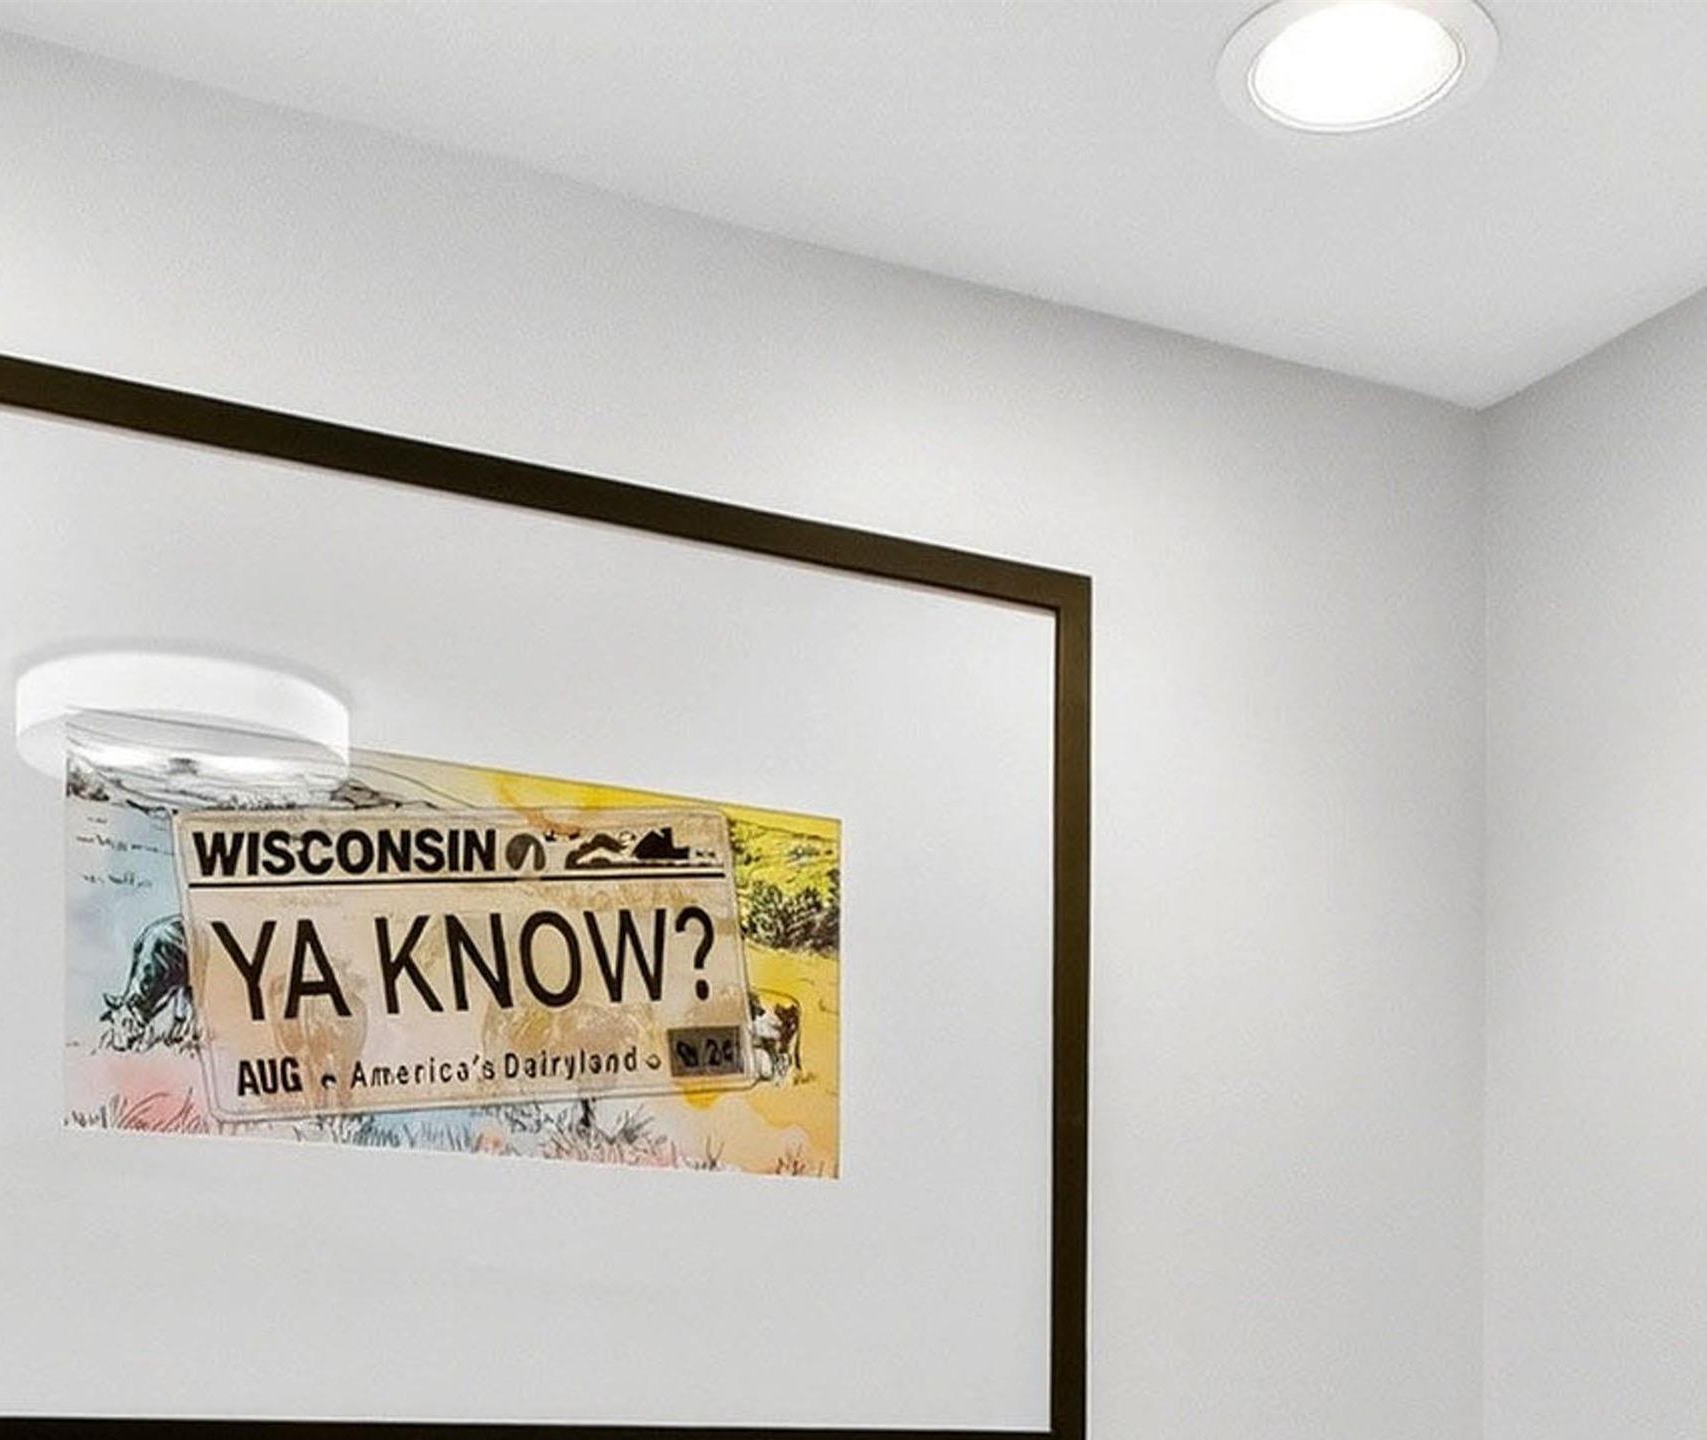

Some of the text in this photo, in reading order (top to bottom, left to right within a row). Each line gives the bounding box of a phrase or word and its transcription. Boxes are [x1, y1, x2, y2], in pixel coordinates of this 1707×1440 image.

[193, 828, 496, 876] WISCONSIN
[211, 905, 714, 1021] YA KNOW?
[237, 1056, 303, 1096] AUG
[349, 1055, 495, 1090] America's
[503, 1046, 637, 1082] Dairyland
